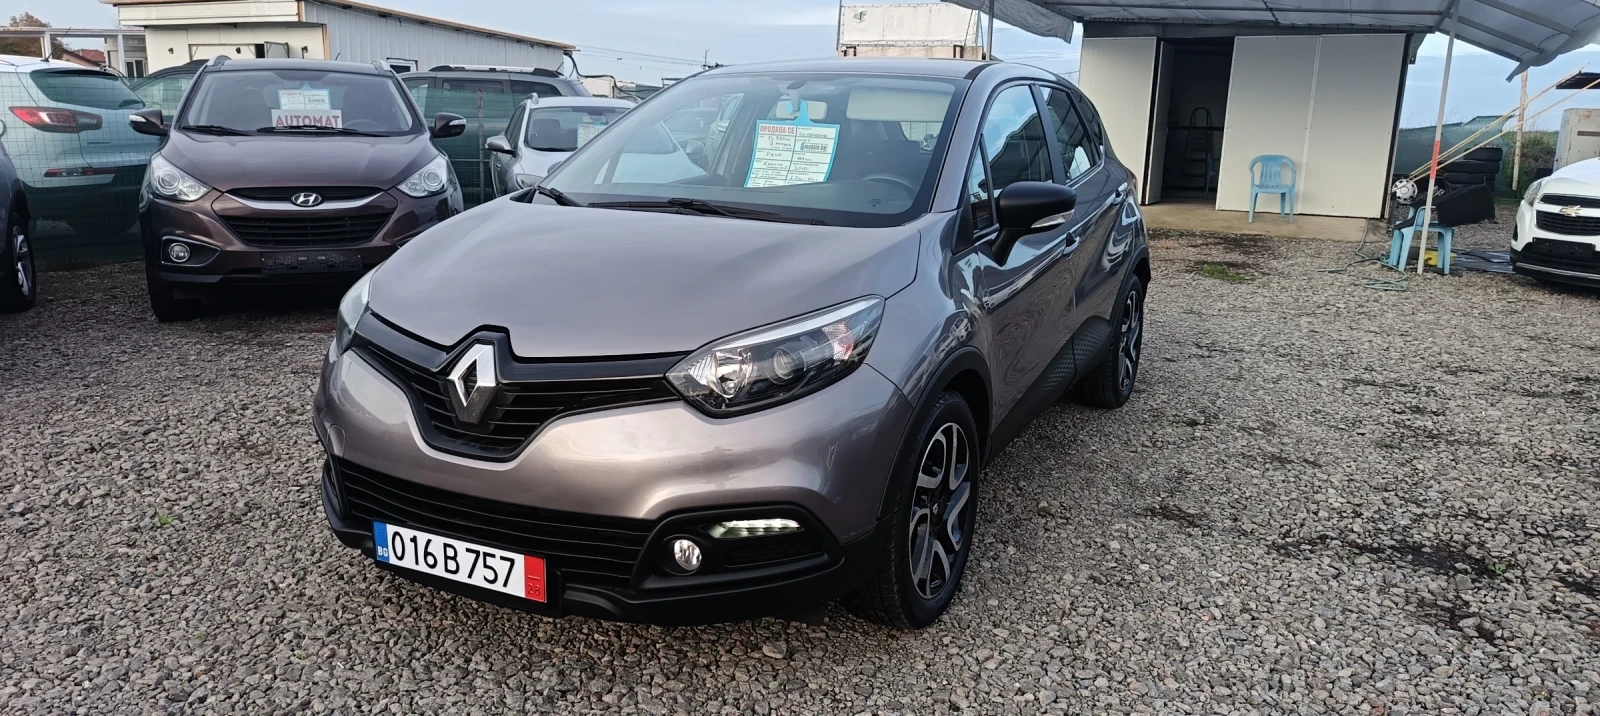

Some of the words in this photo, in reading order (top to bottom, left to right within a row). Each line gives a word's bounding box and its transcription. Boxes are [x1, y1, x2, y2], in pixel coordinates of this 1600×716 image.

[275, 115, 340, 128] AUTOMAT
[760, 125, 786, 134] ПРОДАВА
[787, 127, 795, 135] СЕ
[377, 546, 389, 557] BG
[527, 583, 541, 596] 28
